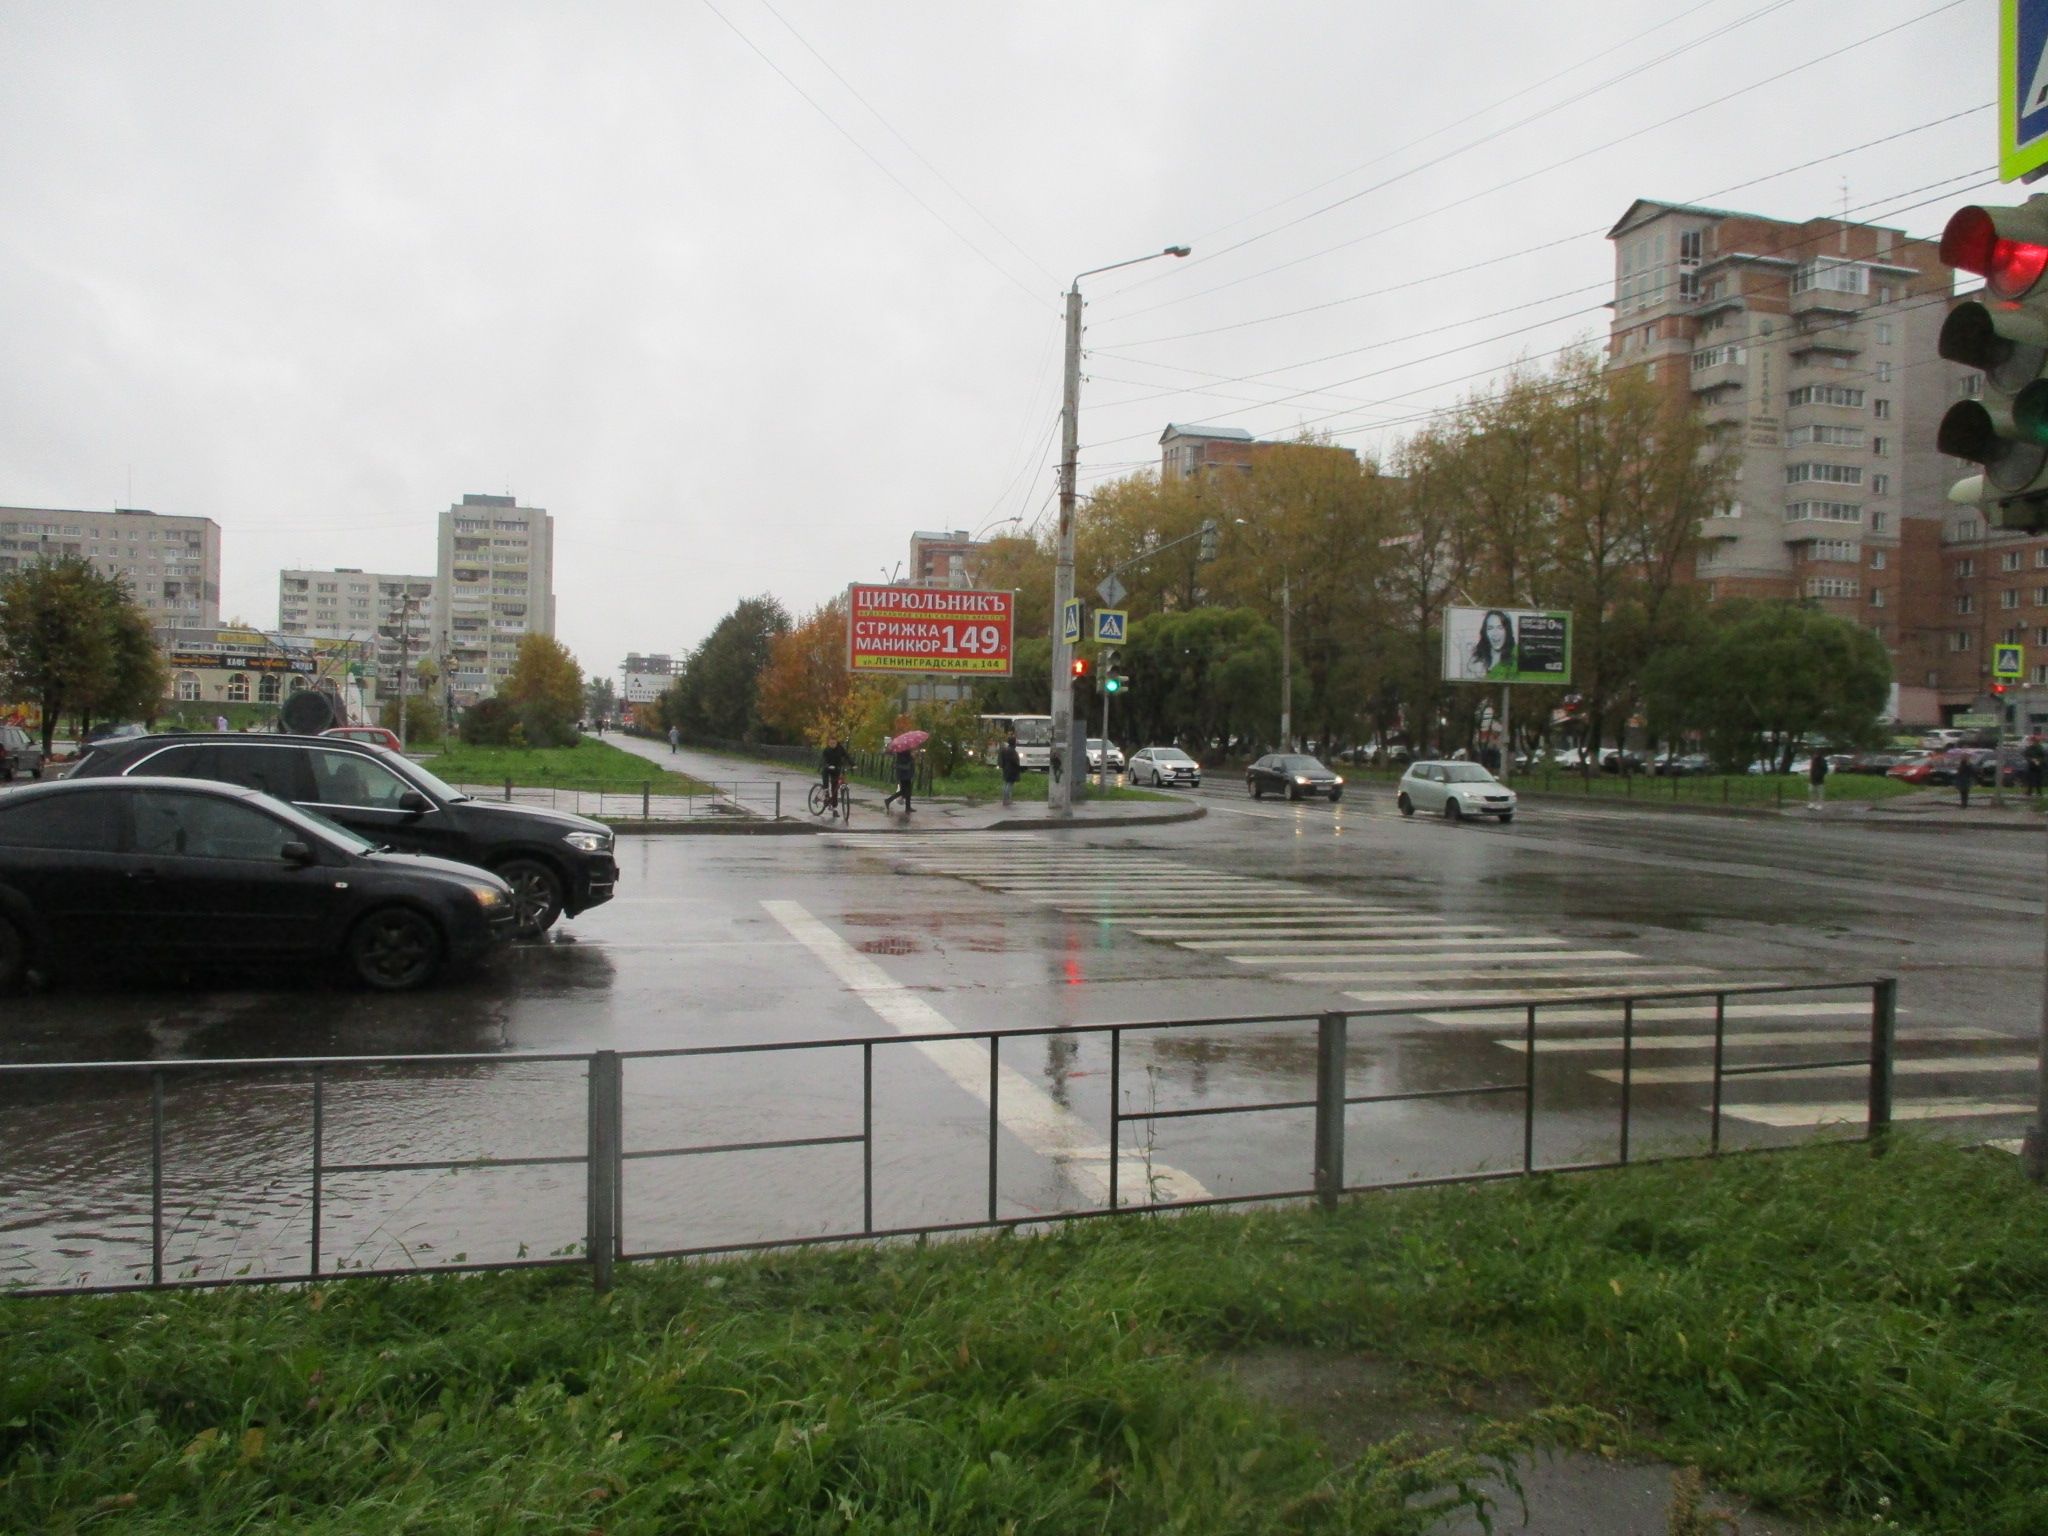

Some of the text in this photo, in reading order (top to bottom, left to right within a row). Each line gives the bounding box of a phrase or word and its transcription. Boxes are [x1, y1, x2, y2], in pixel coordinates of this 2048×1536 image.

[858, 590, 1006, 612] ЦИРЮЛЬНИКЪ
[856, 621, 940, 637] СТРИЖКА
[855, 637, 941, 653] МАНИКЮР
[941, 625, 1000, 655] 149
[226, 657, 246, 667] КАФЕ
[875, 656, 969, 668] ЛЕНИНГРАДСКАЯ
[980, 660, 1000, 668] 144
